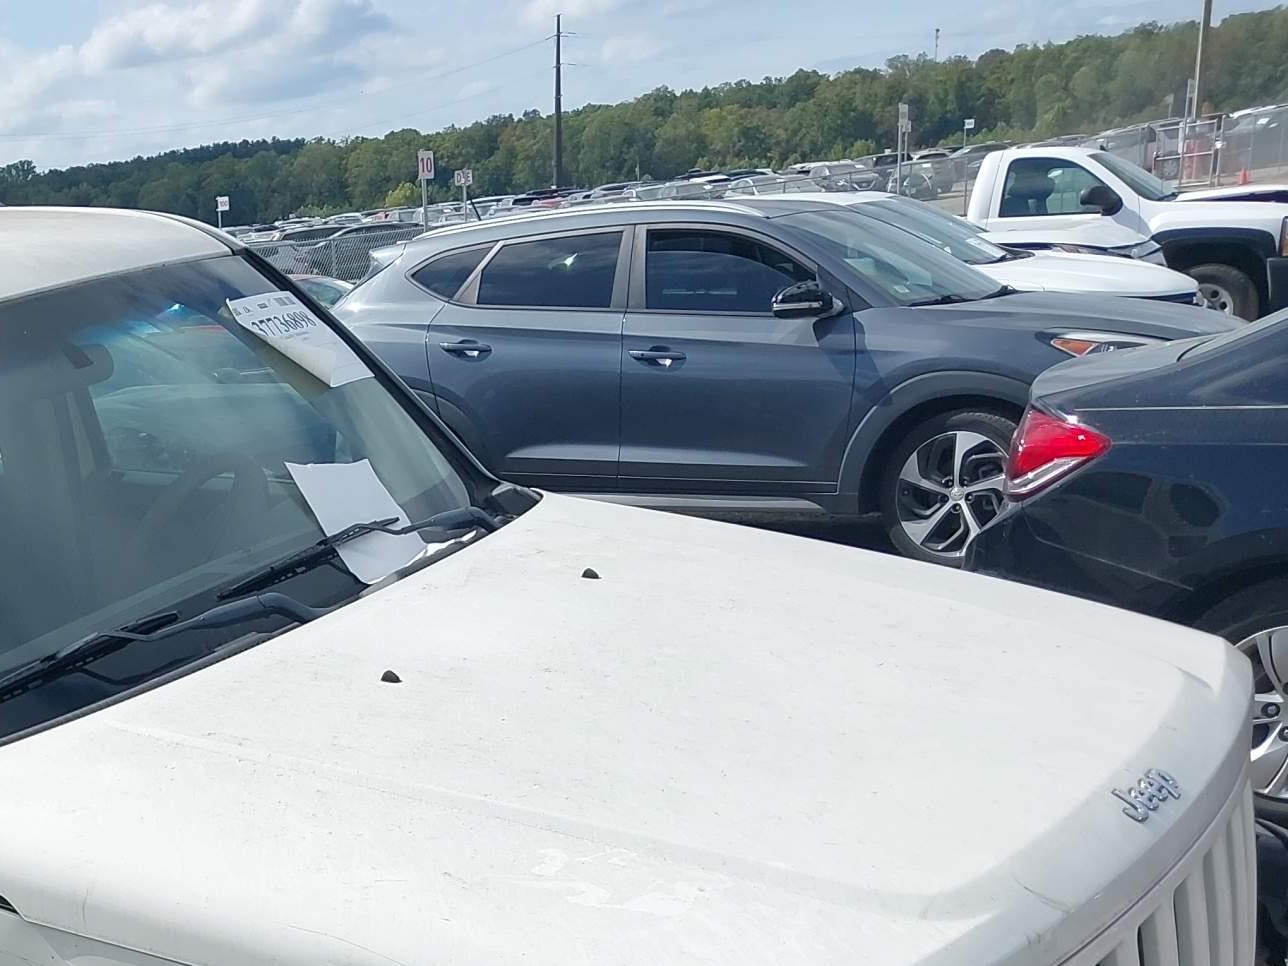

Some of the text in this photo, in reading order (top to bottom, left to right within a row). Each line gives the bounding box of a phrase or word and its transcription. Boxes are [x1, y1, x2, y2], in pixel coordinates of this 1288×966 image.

[420, 157, 432, 173] 10
[251, 311, 318, 337] 37736898
[1110, 767, 1182, 824] Jeep
